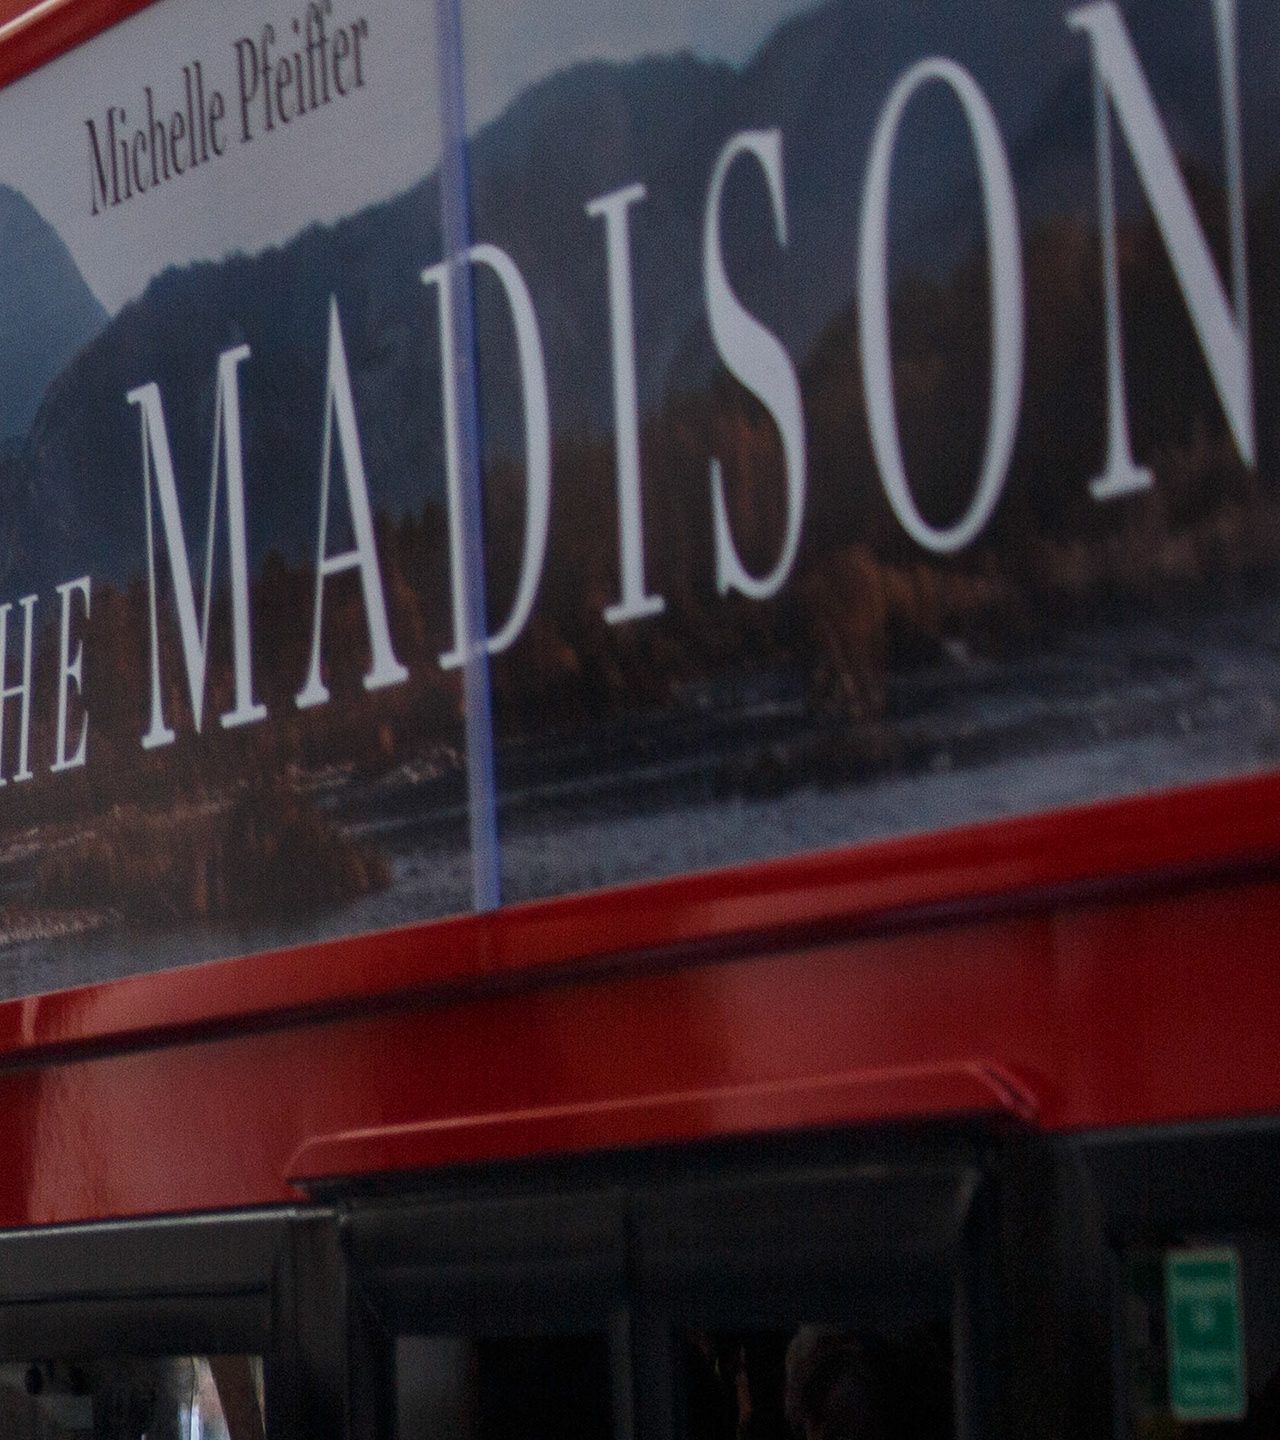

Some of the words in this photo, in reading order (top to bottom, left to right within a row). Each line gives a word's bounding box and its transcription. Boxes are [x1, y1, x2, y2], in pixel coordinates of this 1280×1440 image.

[85, 61, 226, 216] Michelle
[233, 0, 368, 143] Pfeiffer
[127, 0, 1257, 749] MADISON
